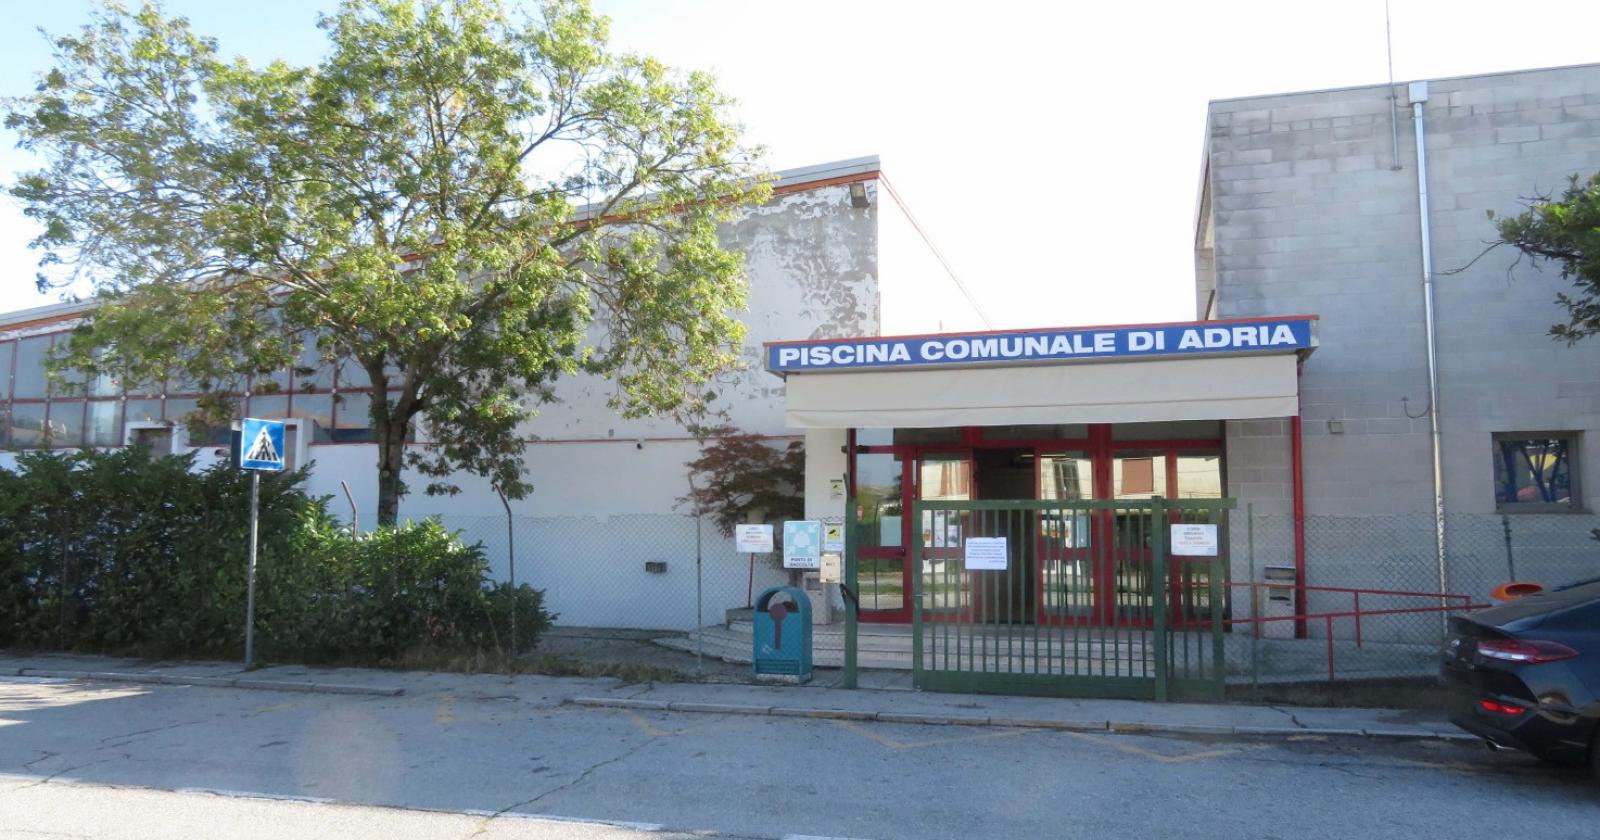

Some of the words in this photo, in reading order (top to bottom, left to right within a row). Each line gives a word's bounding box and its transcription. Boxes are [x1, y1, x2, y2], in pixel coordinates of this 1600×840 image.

[779, 344, 911, 366] PISCINA
[920, 333, 1116, 360] COMUNALE
[1128, 330, 1165, 351] DI
[1178, 325, 1297, 350] ADRIA
